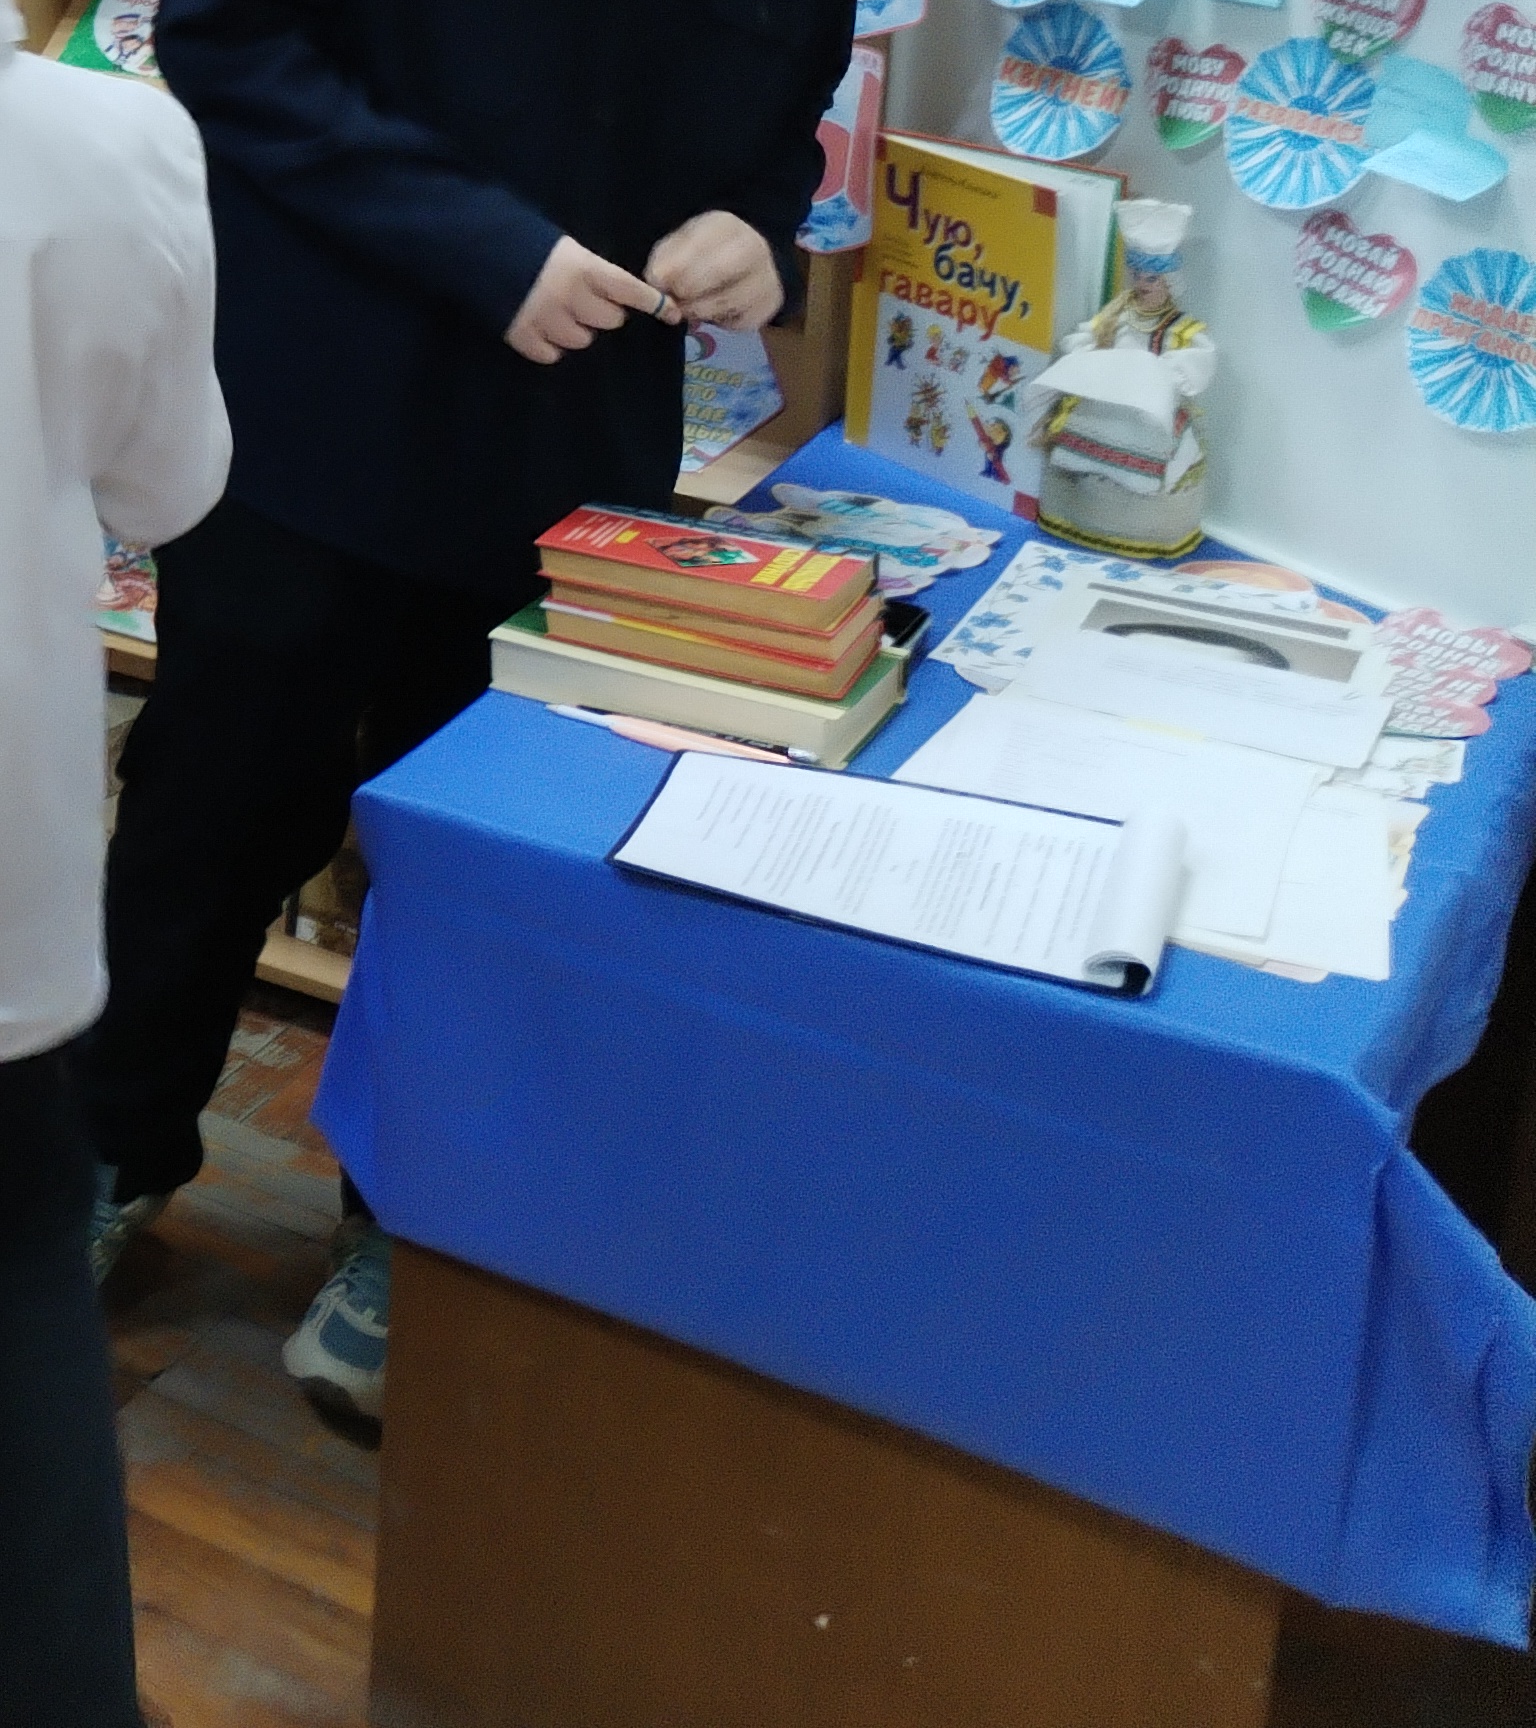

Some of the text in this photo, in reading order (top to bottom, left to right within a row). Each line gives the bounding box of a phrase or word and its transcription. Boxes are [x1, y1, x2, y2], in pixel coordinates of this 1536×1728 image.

[885, 162, 984, 260] Чую,
[879, 267, 1002, 342] гавару
[934, 242, 1030, 319] бачу,
